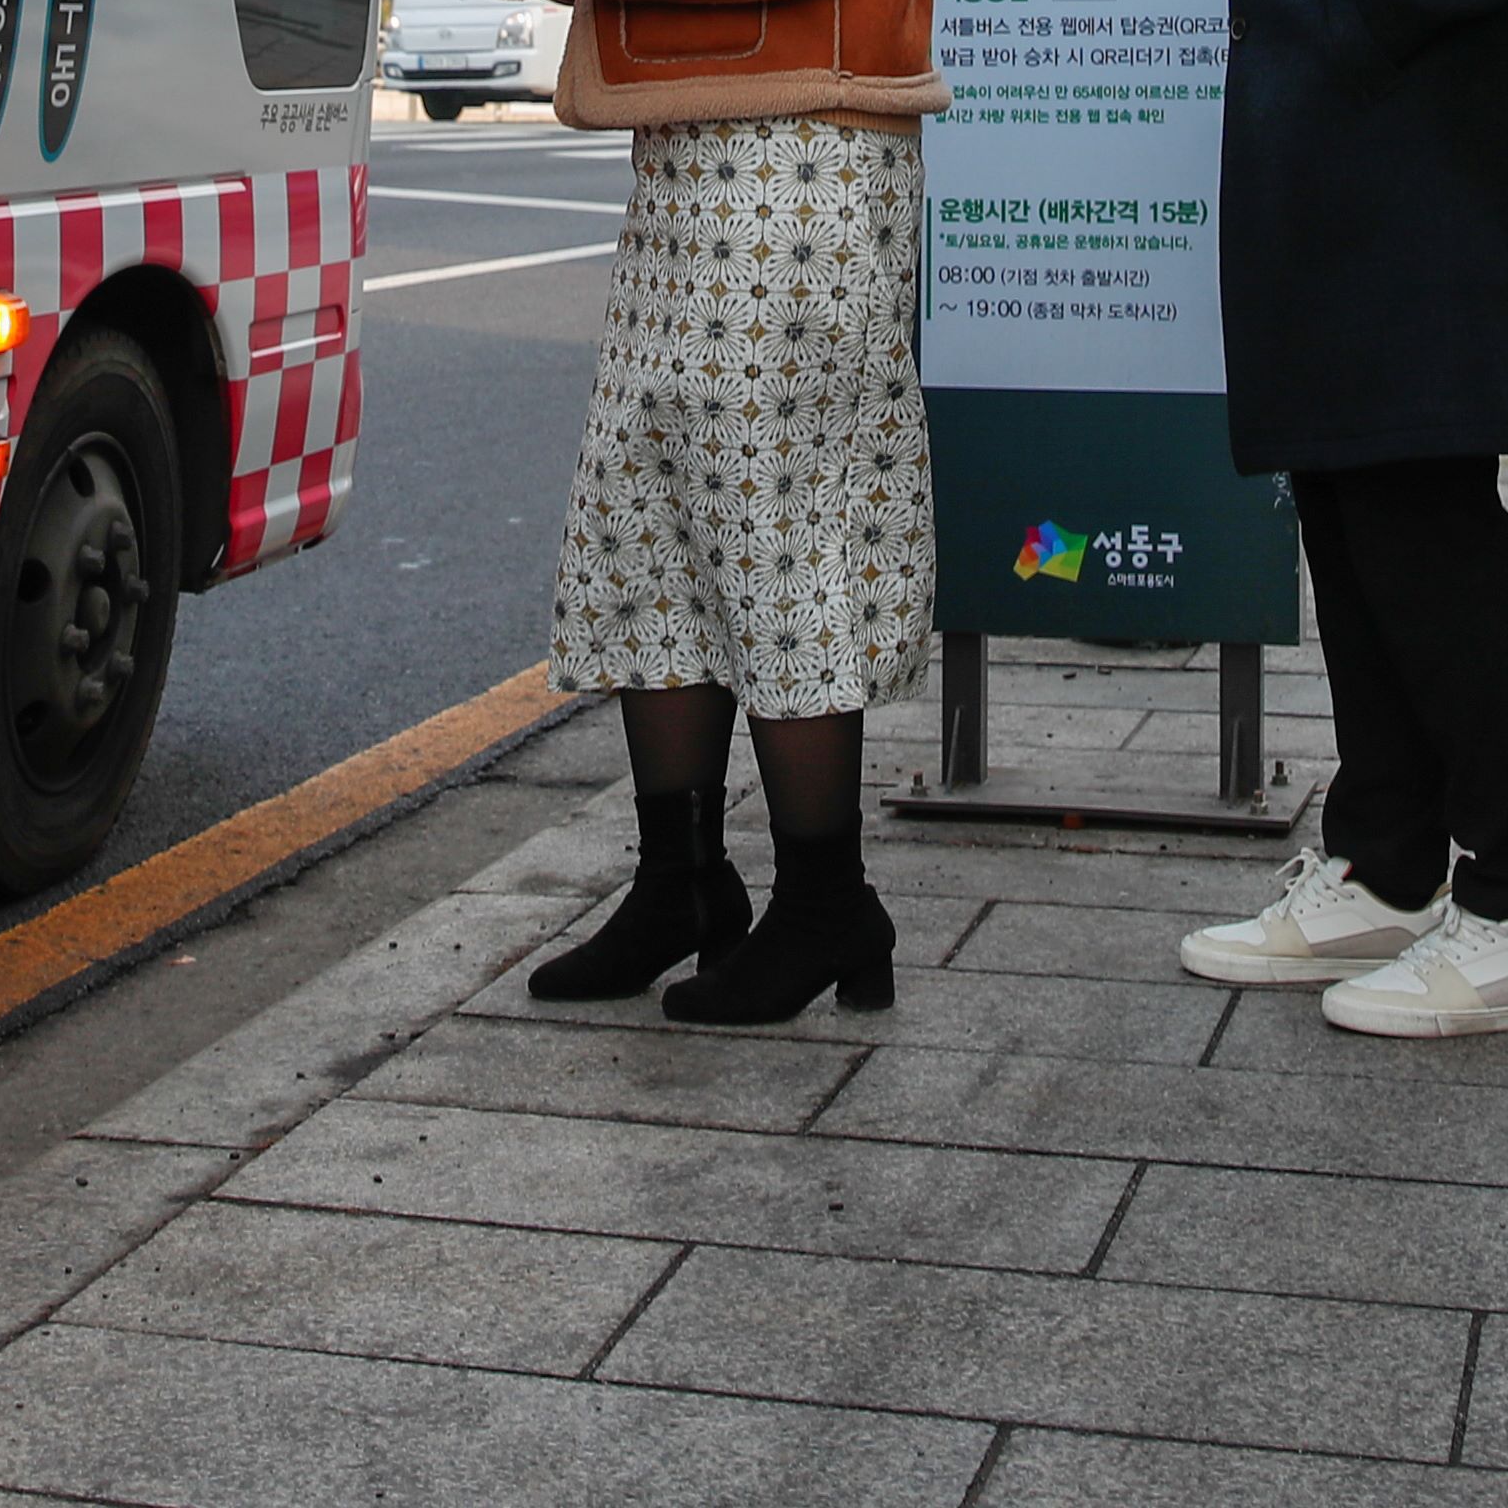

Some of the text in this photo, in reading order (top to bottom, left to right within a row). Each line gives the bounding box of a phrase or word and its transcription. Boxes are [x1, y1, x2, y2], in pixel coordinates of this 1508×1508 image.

[941, 17, 1010, 37] 셔틀버스
[1018, 17, 1053, 37] 전용
[1061, 17, 1112, 36] 웹에서
[941, 47, 975, 67] 발급
[982, 47, 1018, 67] 받아
[1024, 47, 1060, 67] 승차
[1067, 47, 1083, 67] 시
[1091, 47, 1170, 66] QR리더기
[1196, 84, 1224, 100] 신분
[939, 198, 1208, 226] 운행시간 (배차간격 15분)
[1075, 235, 1128, 250] 운행하지
[938, 265, 1150, 288] 08:00 (기점 첫차 출발시간)
[967, 299, 1022, 318] 19:00
[1027, 301, 1064, 320] (종점
[1070, 302, 1102, 320] 막차
[1107, 302, 1177, 321] 도착시간)
[1092, 524, 1183, 568] 성동구
